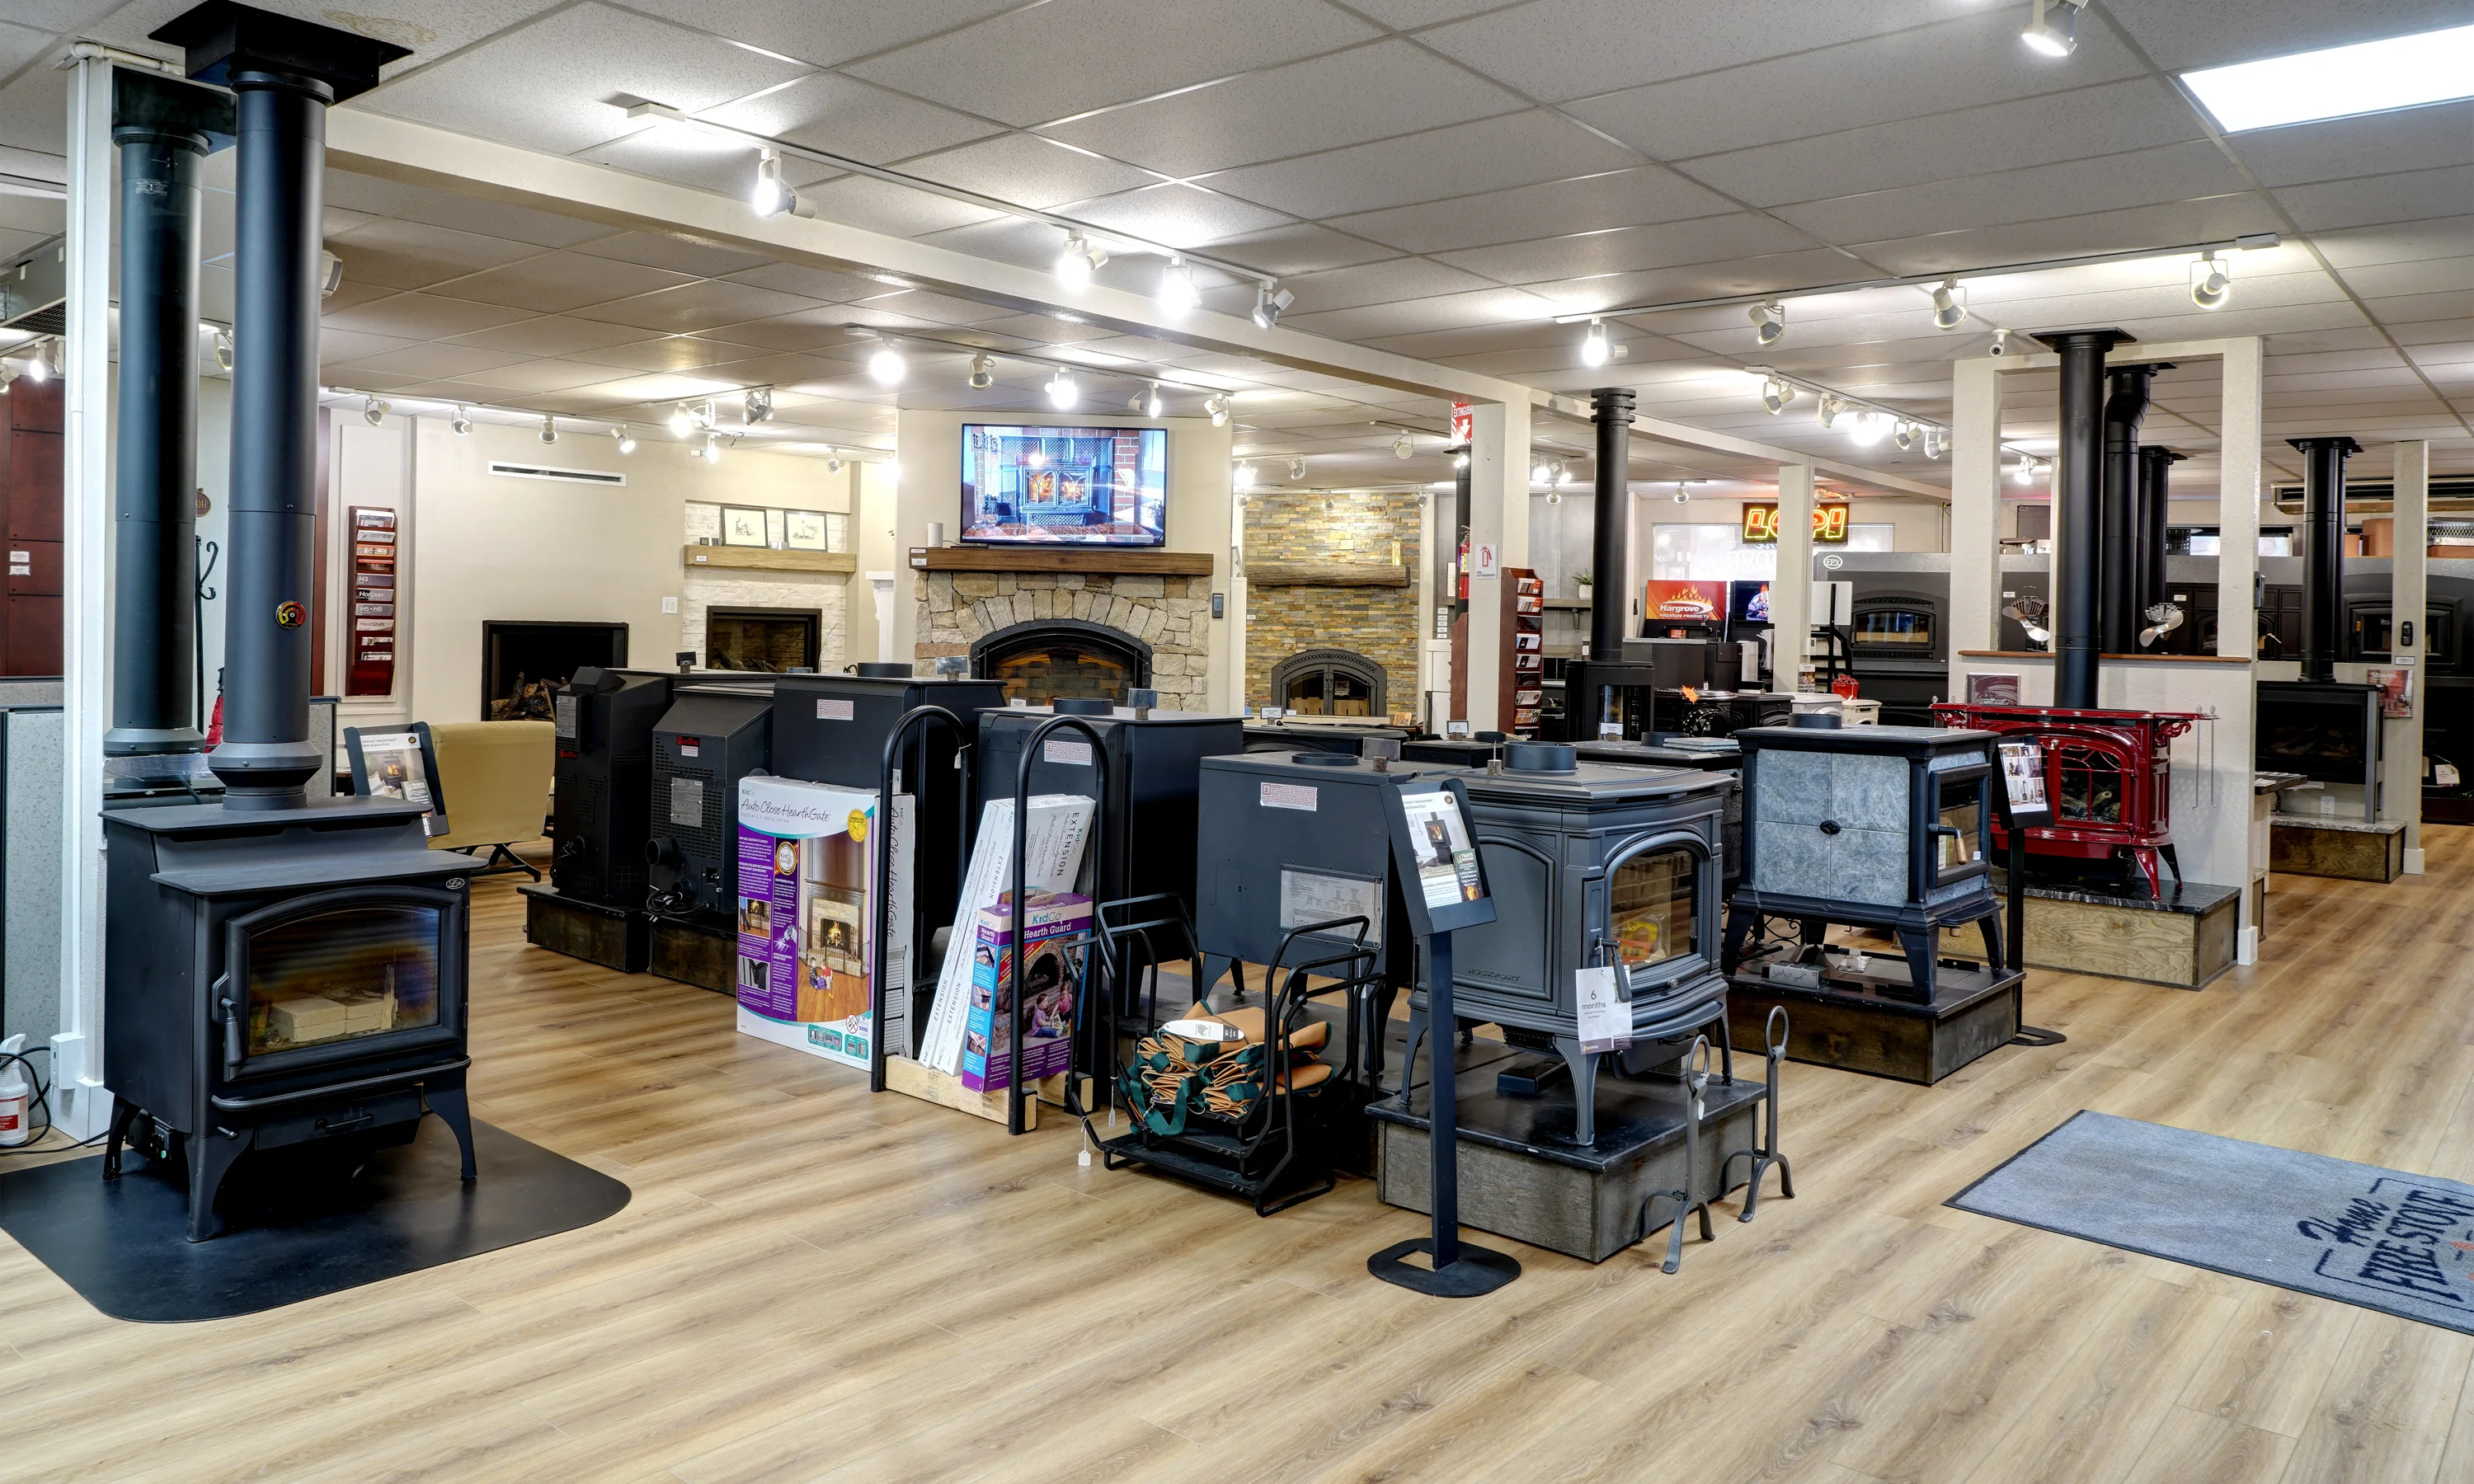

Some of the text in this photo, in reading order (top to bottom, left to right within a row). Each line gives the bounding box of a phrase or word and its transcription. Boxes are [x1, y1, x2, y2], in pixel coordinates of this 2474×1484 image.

[1659, 604, 1700, 613] Hargrove
[741, 788, 755, 796] KidCo
[741, 798, 760, 811] Auto
[760, 801, 781, 815] Close
[763, 815, 789, 824] INSTALLATION
[1056, 812, 1079, 876] EXTENSION
[1071, 828, 1084, 855] KidCo
[990, 855, 1004, 899] EXTENSION
[981, 918, 995, 929] KidCo
[1032, 911, 1062, 925] KidCo
[981, 927, 995, 938] Hearth
[981, 932, 995, 943] Guard
[1024, 922, 1071, 939] Hearth Guard
[1468, 968, 1521, 982] ROCKPORT
[933, 979, 948, 1021] EXTENSION
[1591, 989, 1597, 1000] 6
[947, 982, 962, 1024] EXTENSION
[1582, 1002, 1606, 1010] months
[937, 1045, 945, 1065] KidCo
[2297, 1197, 2391, 1248] Home
[2357, 1239, 2465, 1303] FIRE
